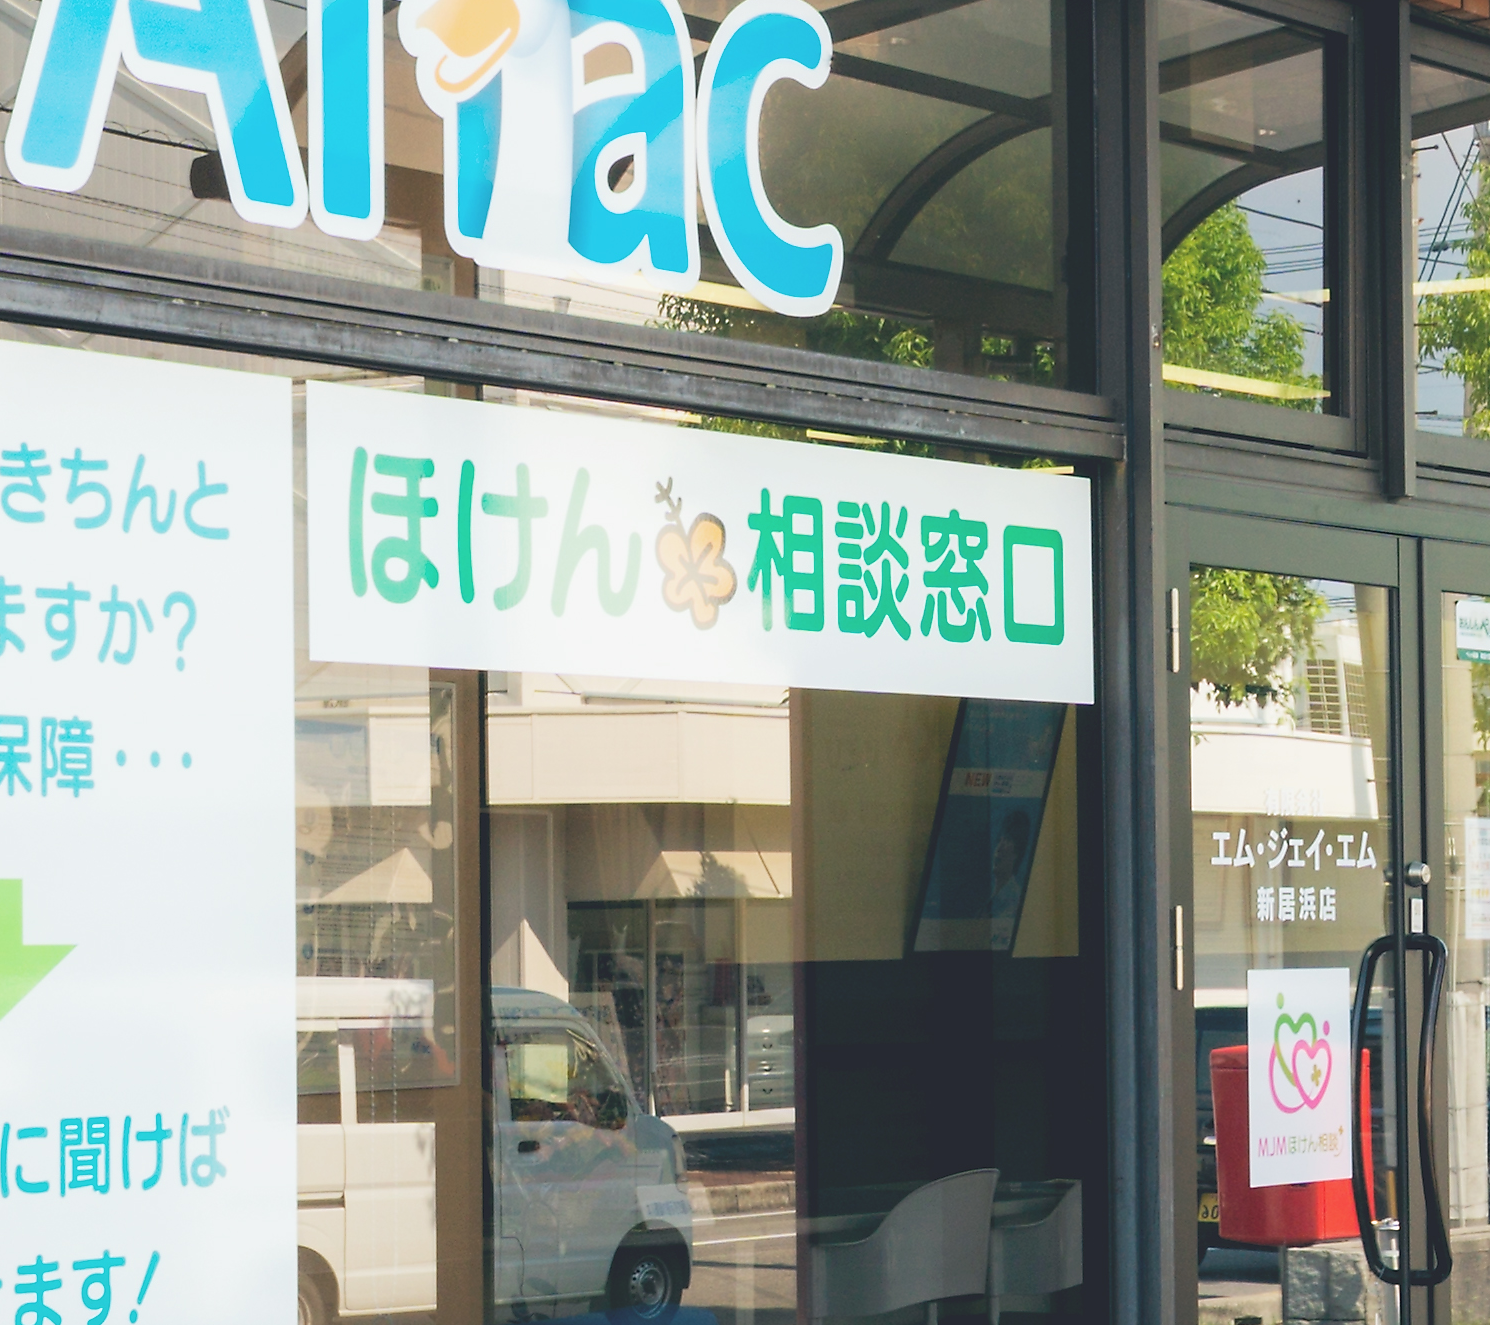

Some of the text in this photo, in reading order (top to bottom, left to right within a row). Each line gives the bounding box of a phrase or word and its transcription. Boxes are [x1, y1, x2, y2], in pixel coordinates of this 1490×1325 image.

[348, 444, 1068, 647] ほけん 相談窓口
[1210, 827, 1377, 871] エム・ジェイ・エム
[1256, 886, 1337, 922] 新居浜店
